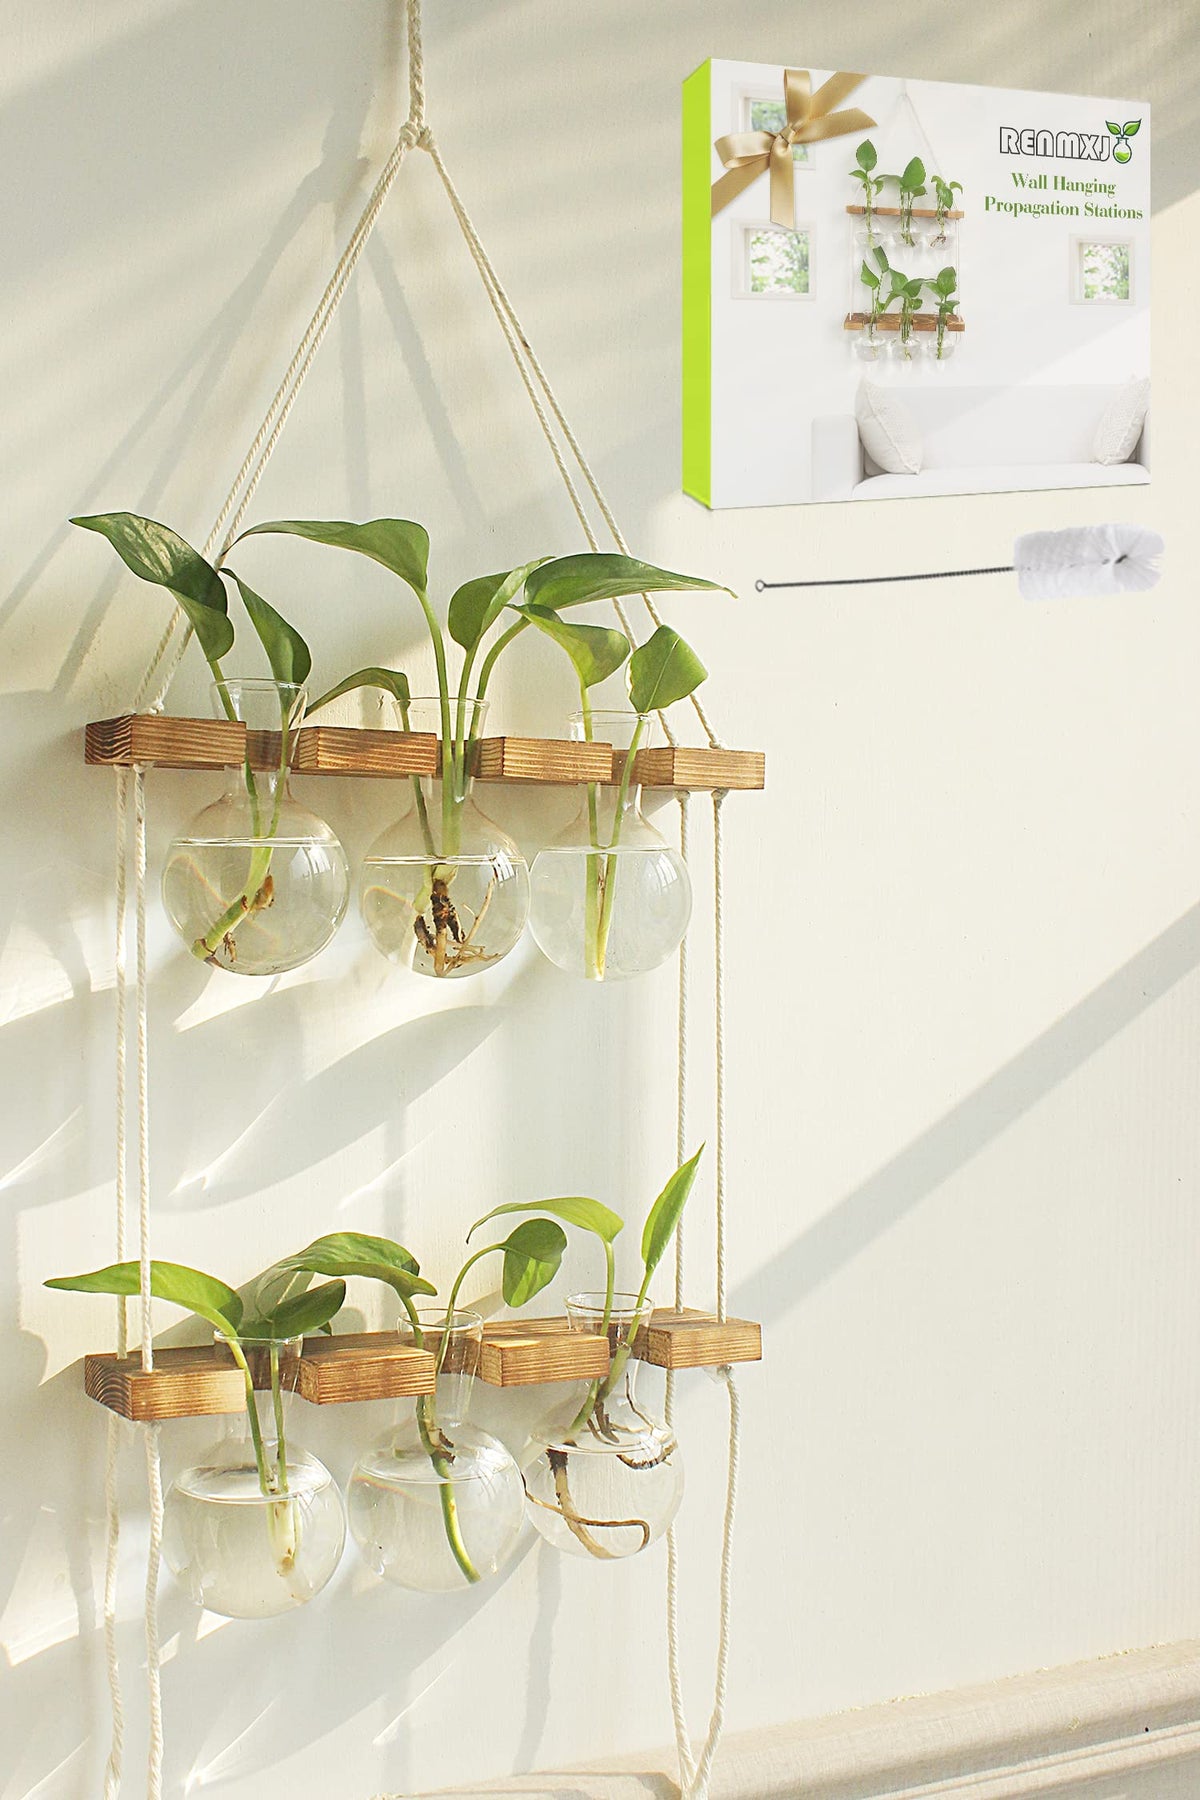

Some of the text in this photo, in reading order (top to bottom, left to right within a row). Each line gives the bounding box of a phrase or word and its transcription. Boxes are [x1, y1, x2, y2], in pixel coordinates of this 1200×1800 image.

[1011, 172, 1117, 199] Wall Hanging
[984, 195, 1144, 220] Propagation Stations
